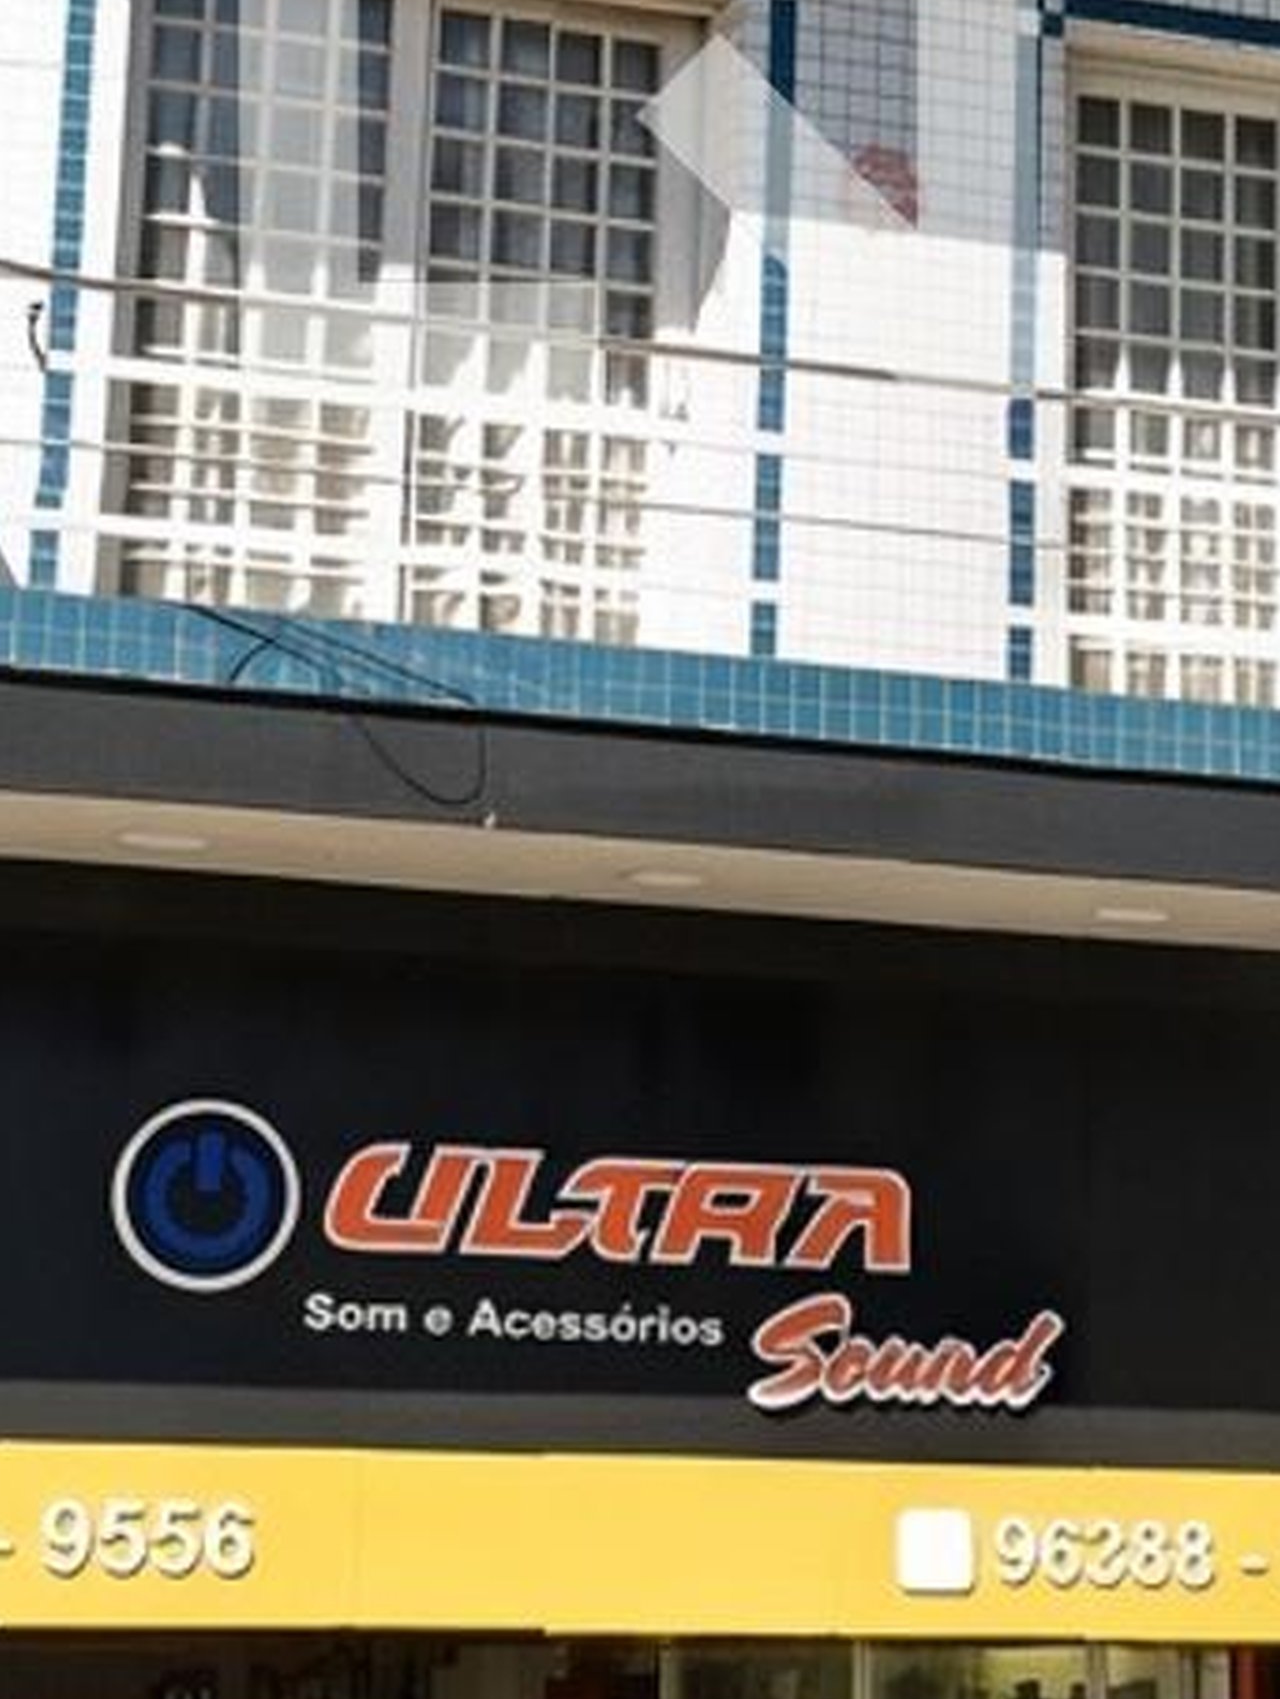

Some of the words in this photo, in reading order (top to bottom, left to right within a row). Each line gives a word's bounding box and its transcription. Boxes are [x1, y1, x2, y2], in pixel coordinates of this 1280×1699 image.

[324, 1142, 910, 1272] ULTRA
[303, 1292, 407, 1333] Som
[424, 1304, 452, 1338] e
[468, 1298, 725, 1347] Acessórios
[748, 1292, 1065, 1410] Sound
[41, 1497, 257, 1581] 9556
